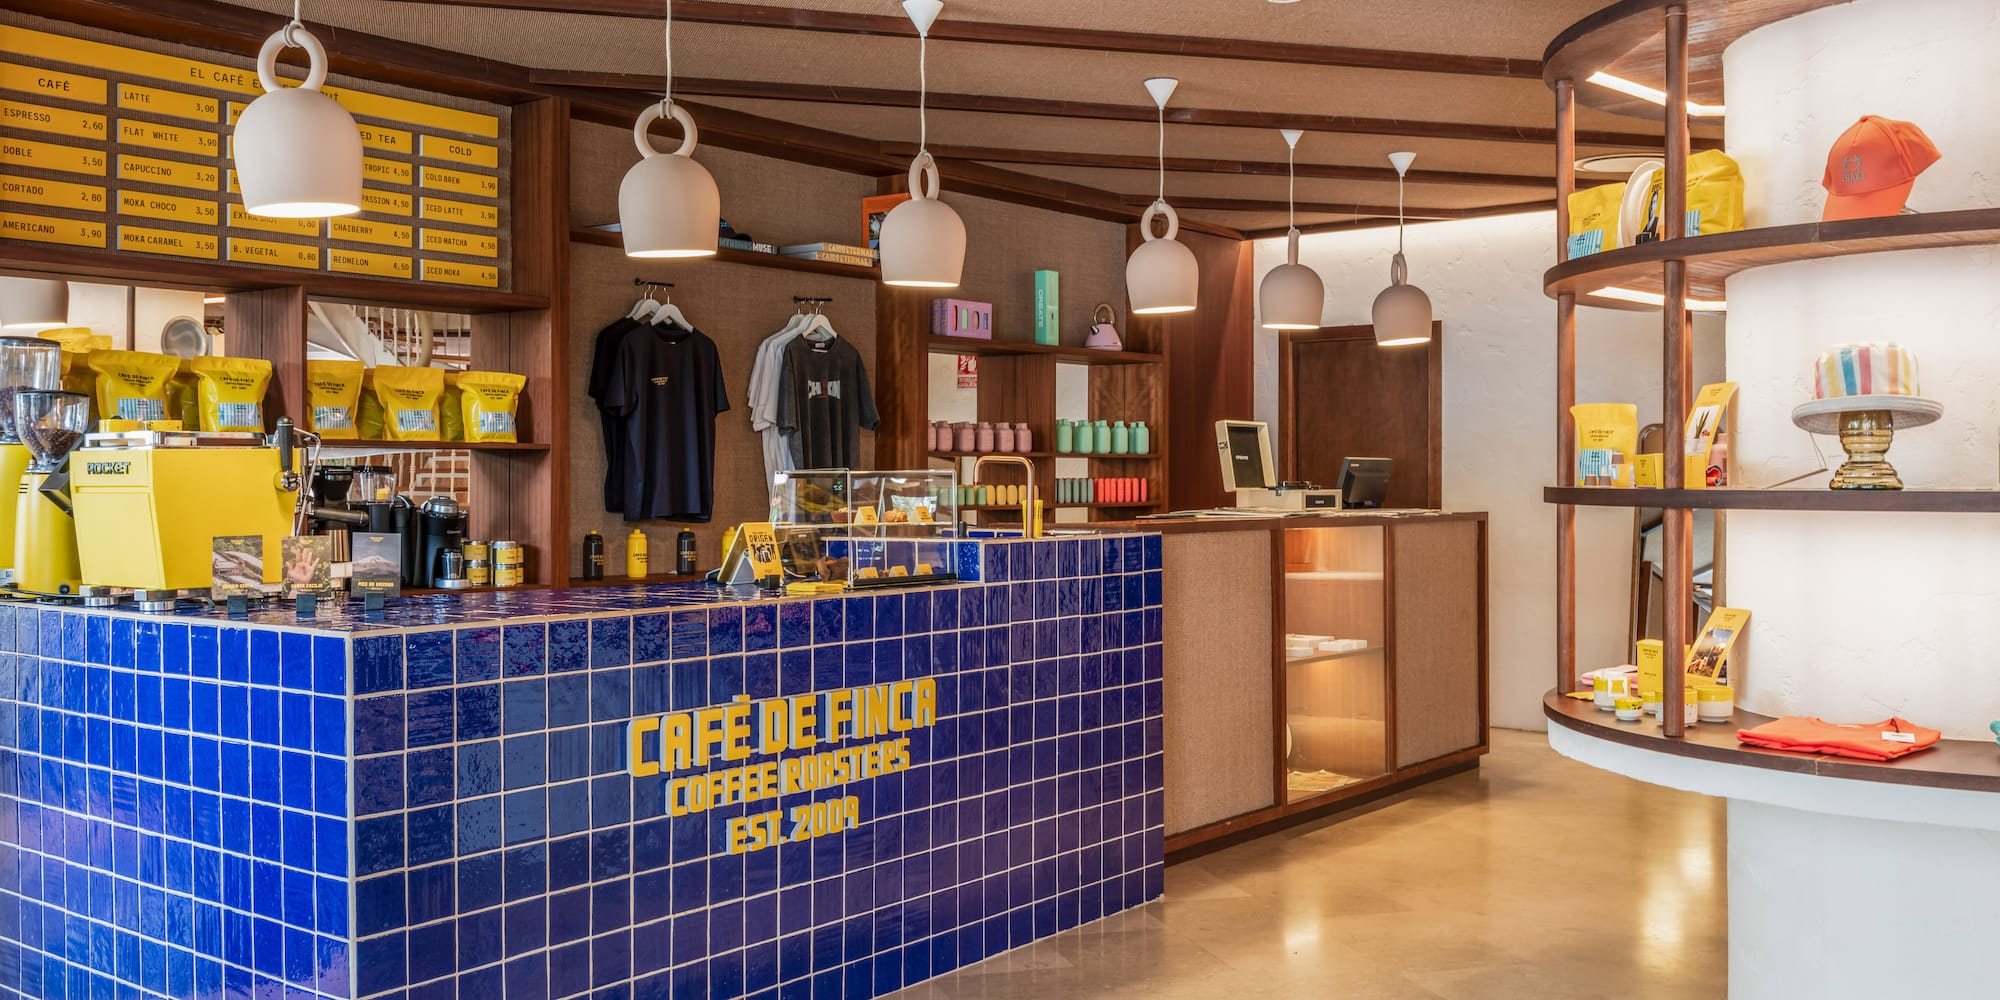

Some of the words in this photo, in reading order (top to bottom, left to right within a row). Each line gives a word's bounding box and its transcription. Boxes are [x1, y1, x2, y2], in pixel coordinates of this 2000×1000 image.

[38, 78, 70, 91] CAFÉ
[190, 68, 204, 79] EL
[214, 72, 243, 85] CAFÉ
[124, 92, 150, 102] LATTE
[196, 103, 214, 113] 3,00
[4, 108, 50, 122] ESPRESSO
[82, 120, 103, 130] 2,60
[124, 127, 144, 137] FLAT
[153, 131, 179, 142] WHITE
[198, 138, 217, 147] 3,90
[361, 132, 371, 140] ED
[379, 135, 395, 144] TEA
[4, 146, 32, 157] DOBLE
[82, 156, 102, 167] 3,50
[449, 145, 472, 156] COLD
[124, 163, 172, 176] CAPUCCINO
[196, 173, 215, 182] 3,20
[365, 164, 389, 174] TROPIC
[393, 168, 409, 176] 4,50
[426, 173, 442, 182] COLD
[444, 175, 460, 184] BREW
[481, 182, 496, 190] 3,90
[2, 182, 44, 195] CORTADO
[81, 192, 102, 202] 2,80
[124, 198, 145, 208] MOKA
[150, 201, 176, 211] CHOCO
[196, 207, 214, 216] 3,50
[394, 200, 409, 208] 4,50
[426, 204, 442, 212] ICED
[444, 206, 463, 215] LATTE
[481, 212, 495, 220] 3,90
[2, 221, 55, 234] AMERICANO
[80, 228, 102, 238] 3,90
[334, 224, 373, 234] CHAIBERRY
[393, 231, 409, 240] 4,50
[124, 233, 145, 243] MOKA
[148, 236, 183, 247] CARAMEL
[196, 241, 214, 250] 3,50
[426, 235, 442, 244] ICED
[444, 237, 468, 246] MATCHA
[753, 242, 771, 254] MUSE
[234, 245, 242, 253] B.
[246, 246, 278, 257] VEGETAL
[298, 252, 316, 260] 0,80
[334, 256, 369, 266] REDMELON
[393, 262, 409, 271] 4,50
[427, 266, 443, 275] ICED
[444, 268, 460, 277] MOKA
[87, 462, 131, 474] ROCKET
[749, 534, 772, 542] ORIGEN
[626, 694, 751, 778] CAFÉ
[759, 694, 816, 755] DE
[825, 678, 936, 744] FINCA
[665, 760, 778, 817] COFFEE
[781, 738, 910, 794] ROASTERS
[726, 810, 787, 855] EST.
[786, 795, 859, 842] 2009
